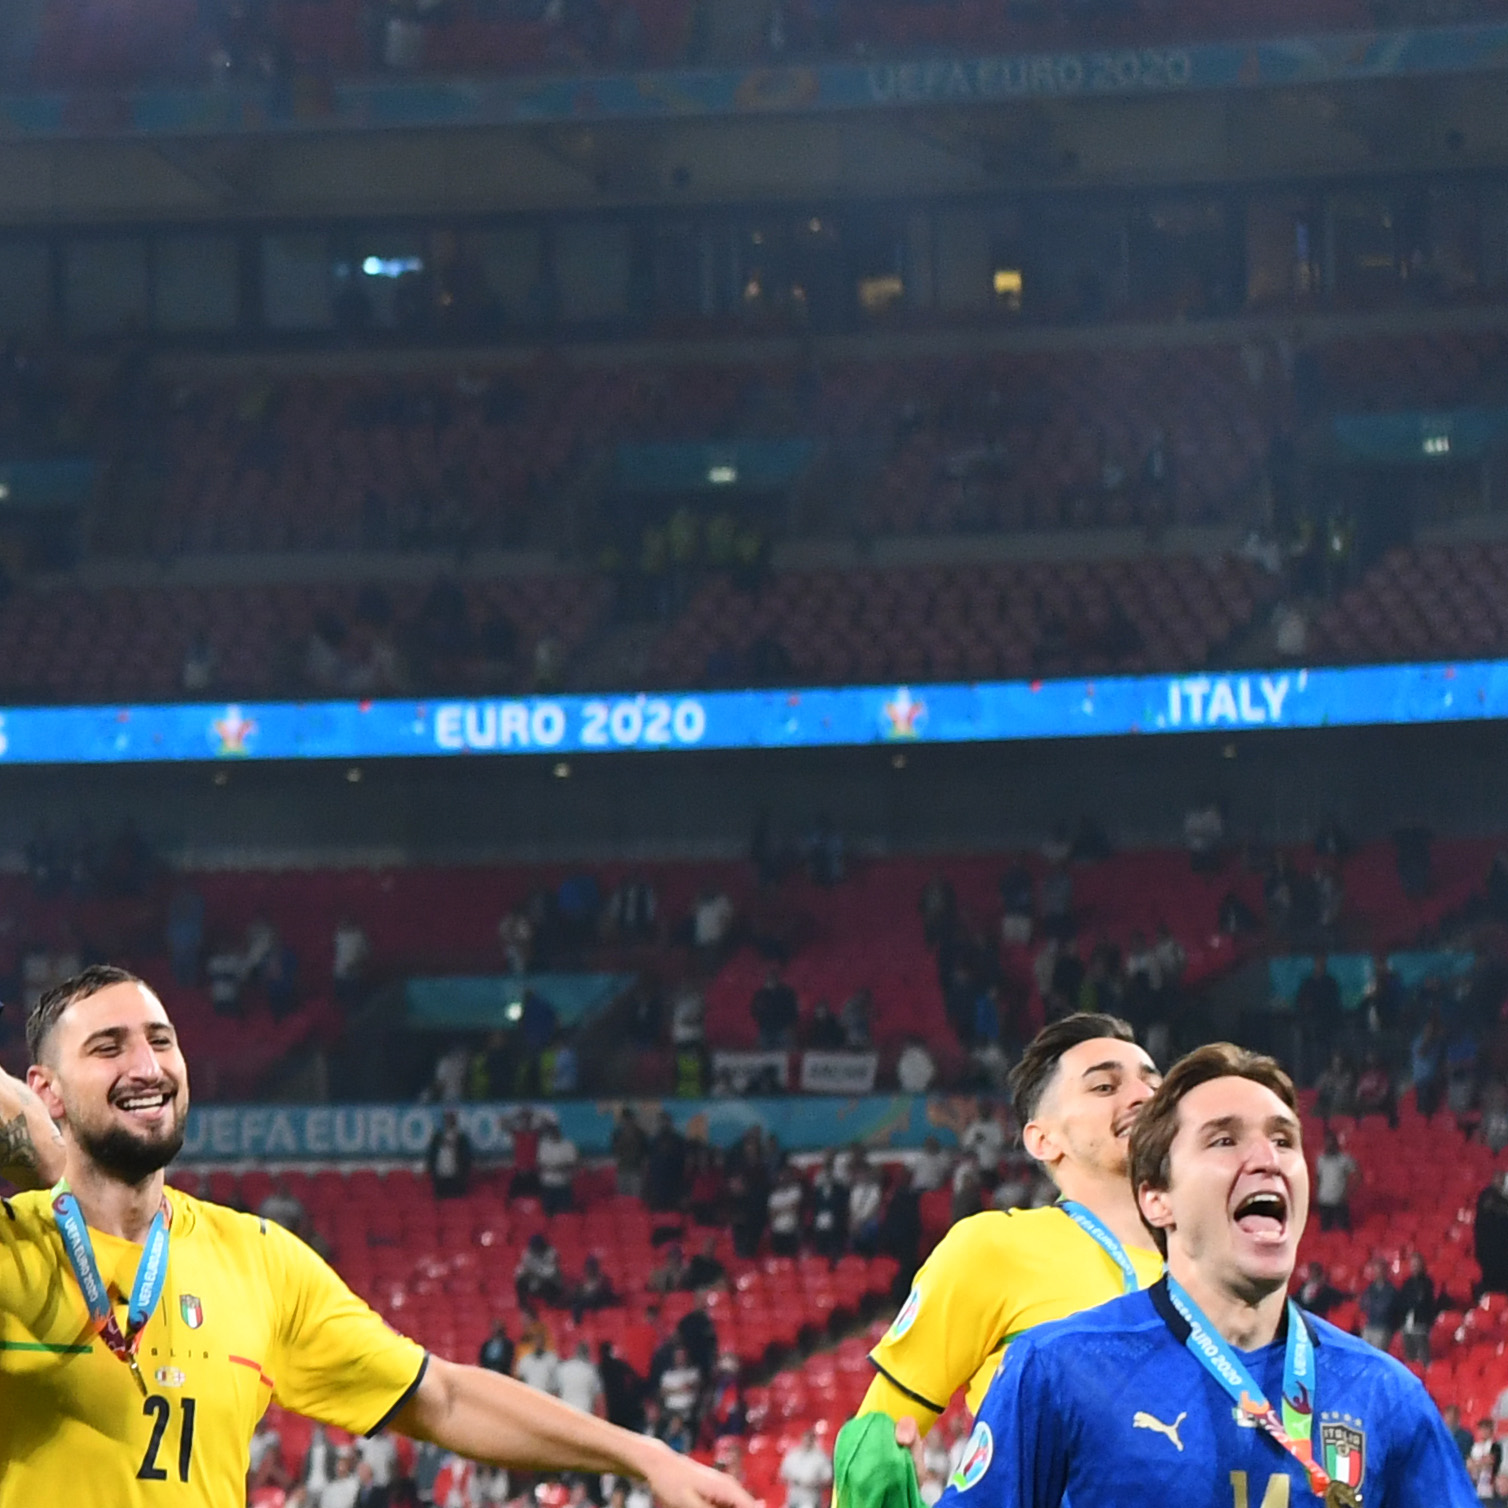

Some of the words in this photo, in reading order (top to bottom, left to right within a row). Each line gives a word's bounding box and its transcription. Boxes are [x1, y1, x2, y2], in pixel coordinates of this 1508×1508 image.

[869, 62, 975, 101] UEFA
[979, 57, 1083, 95] EURO
[1091, 51, 1191, 91] 2020
[436, 701, 565, 747] EURO
[580, 699, 705, 742] 2020
[1167, 676, 1288, 725] ITALY
[306, 1108, 434, 1150] EURO
[72, 1244, 91, 1278] EURO
[83, 1272, 100, 1303] 2020
[1210, 1350, 1245, 1387] 2020
[136, 1394, 195, 1483] 21
[1321, 1426, 1361, 1446] ITALIA
